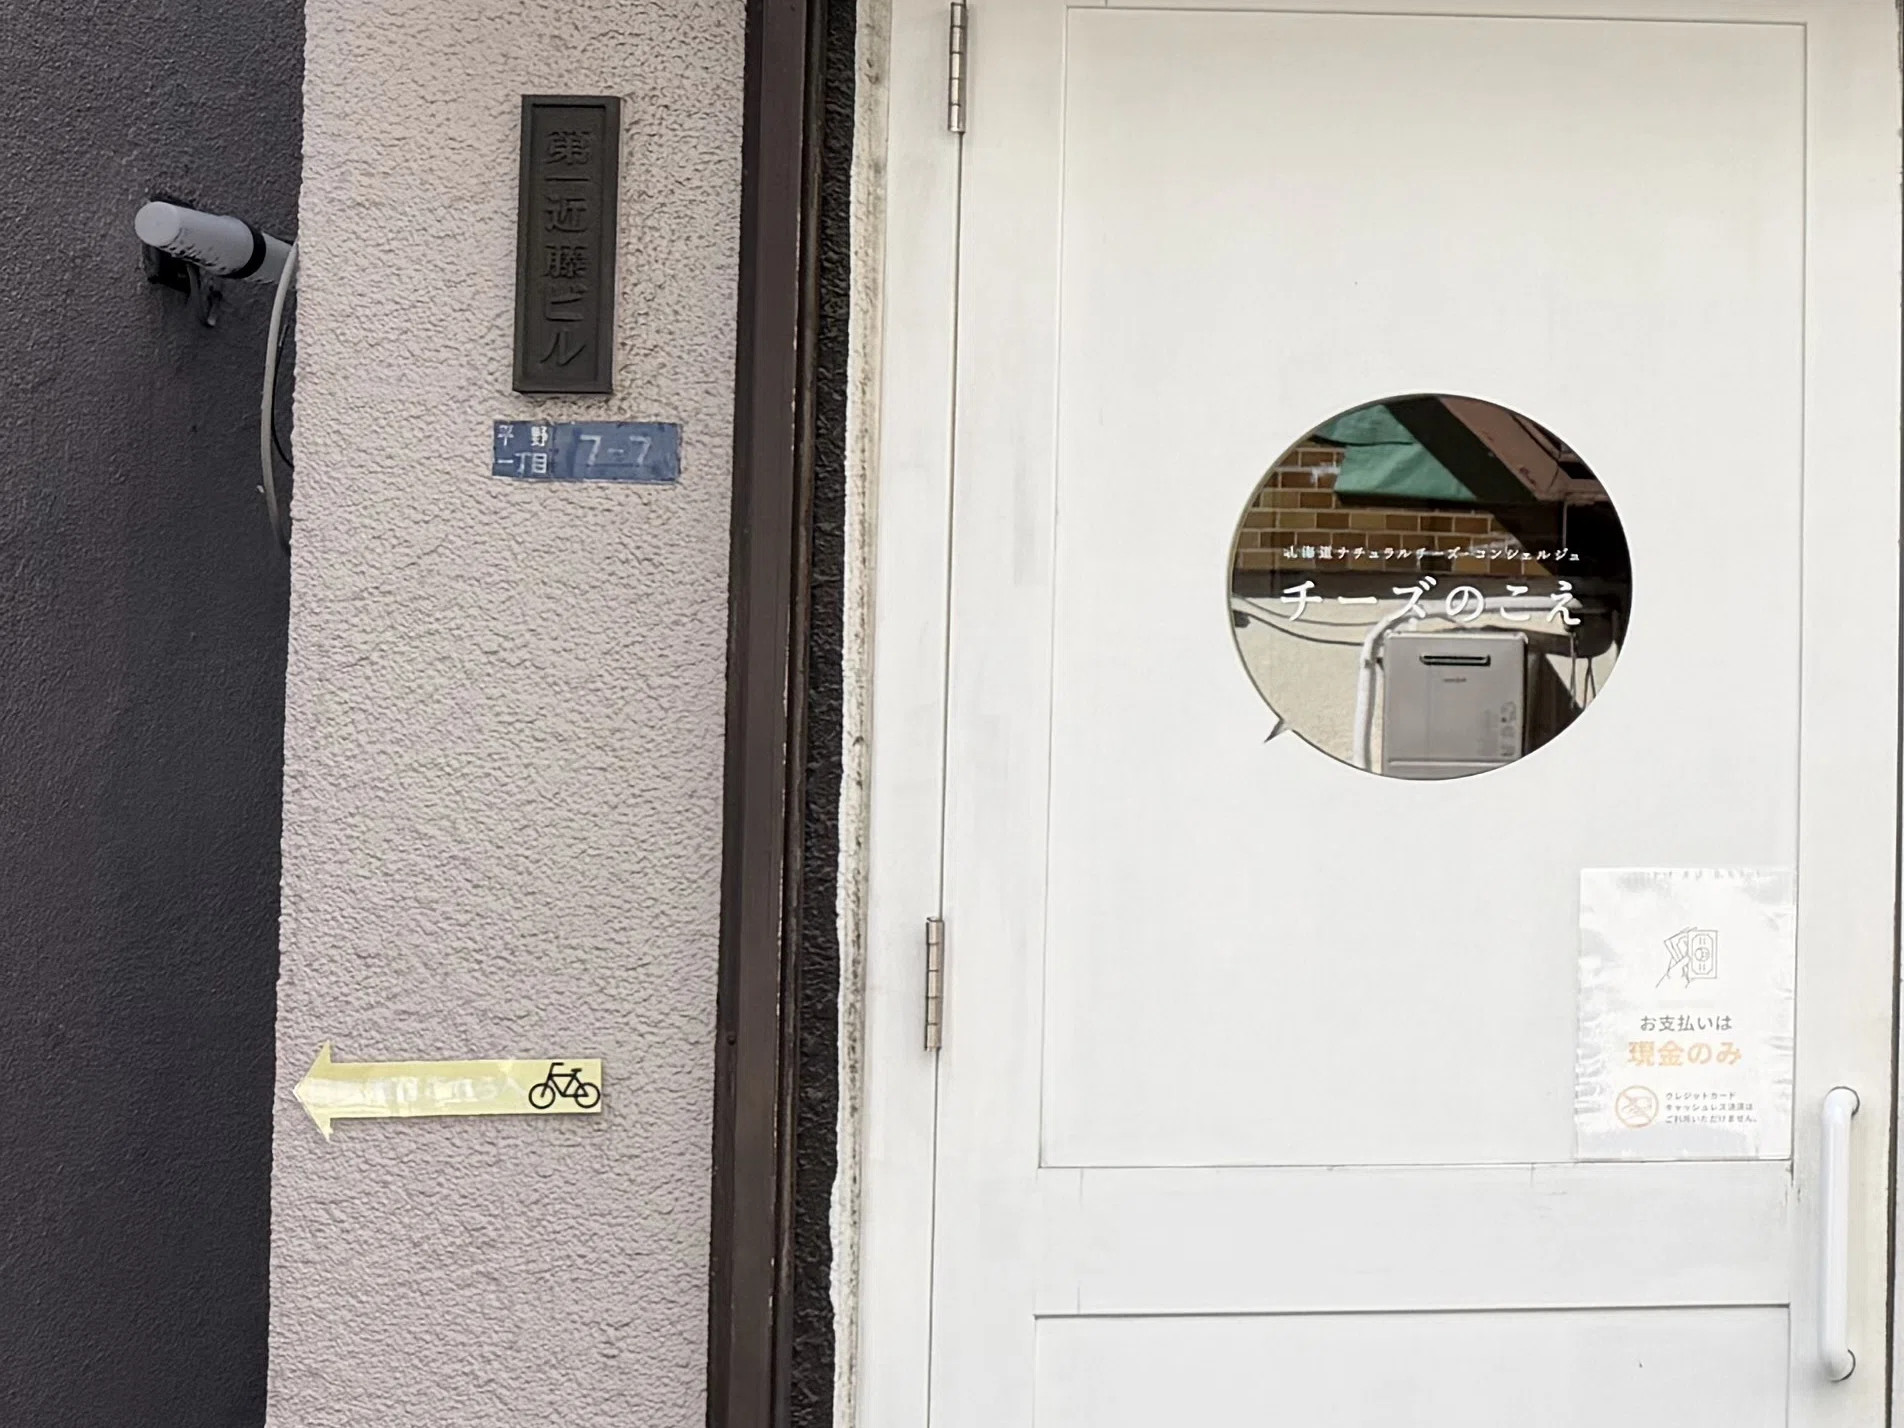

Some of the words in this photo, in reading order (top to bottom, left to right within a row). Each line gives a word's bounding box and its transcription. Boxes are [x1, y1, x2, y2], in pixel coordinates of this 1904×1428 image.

[540, 129, 593, 368] 第一近藤ビル
[497, 424, 549, 447] 平野
[497, 452, 548, 478] 一丁目
[1280, 576, 1582, 626] チーズのこえ
[1640, 1014, 1733, 1032] お支払いは
[1627, 1039, 1743, 1067] 現金のみ
[1664, 1091, 1737, 1101] クレジットカード
